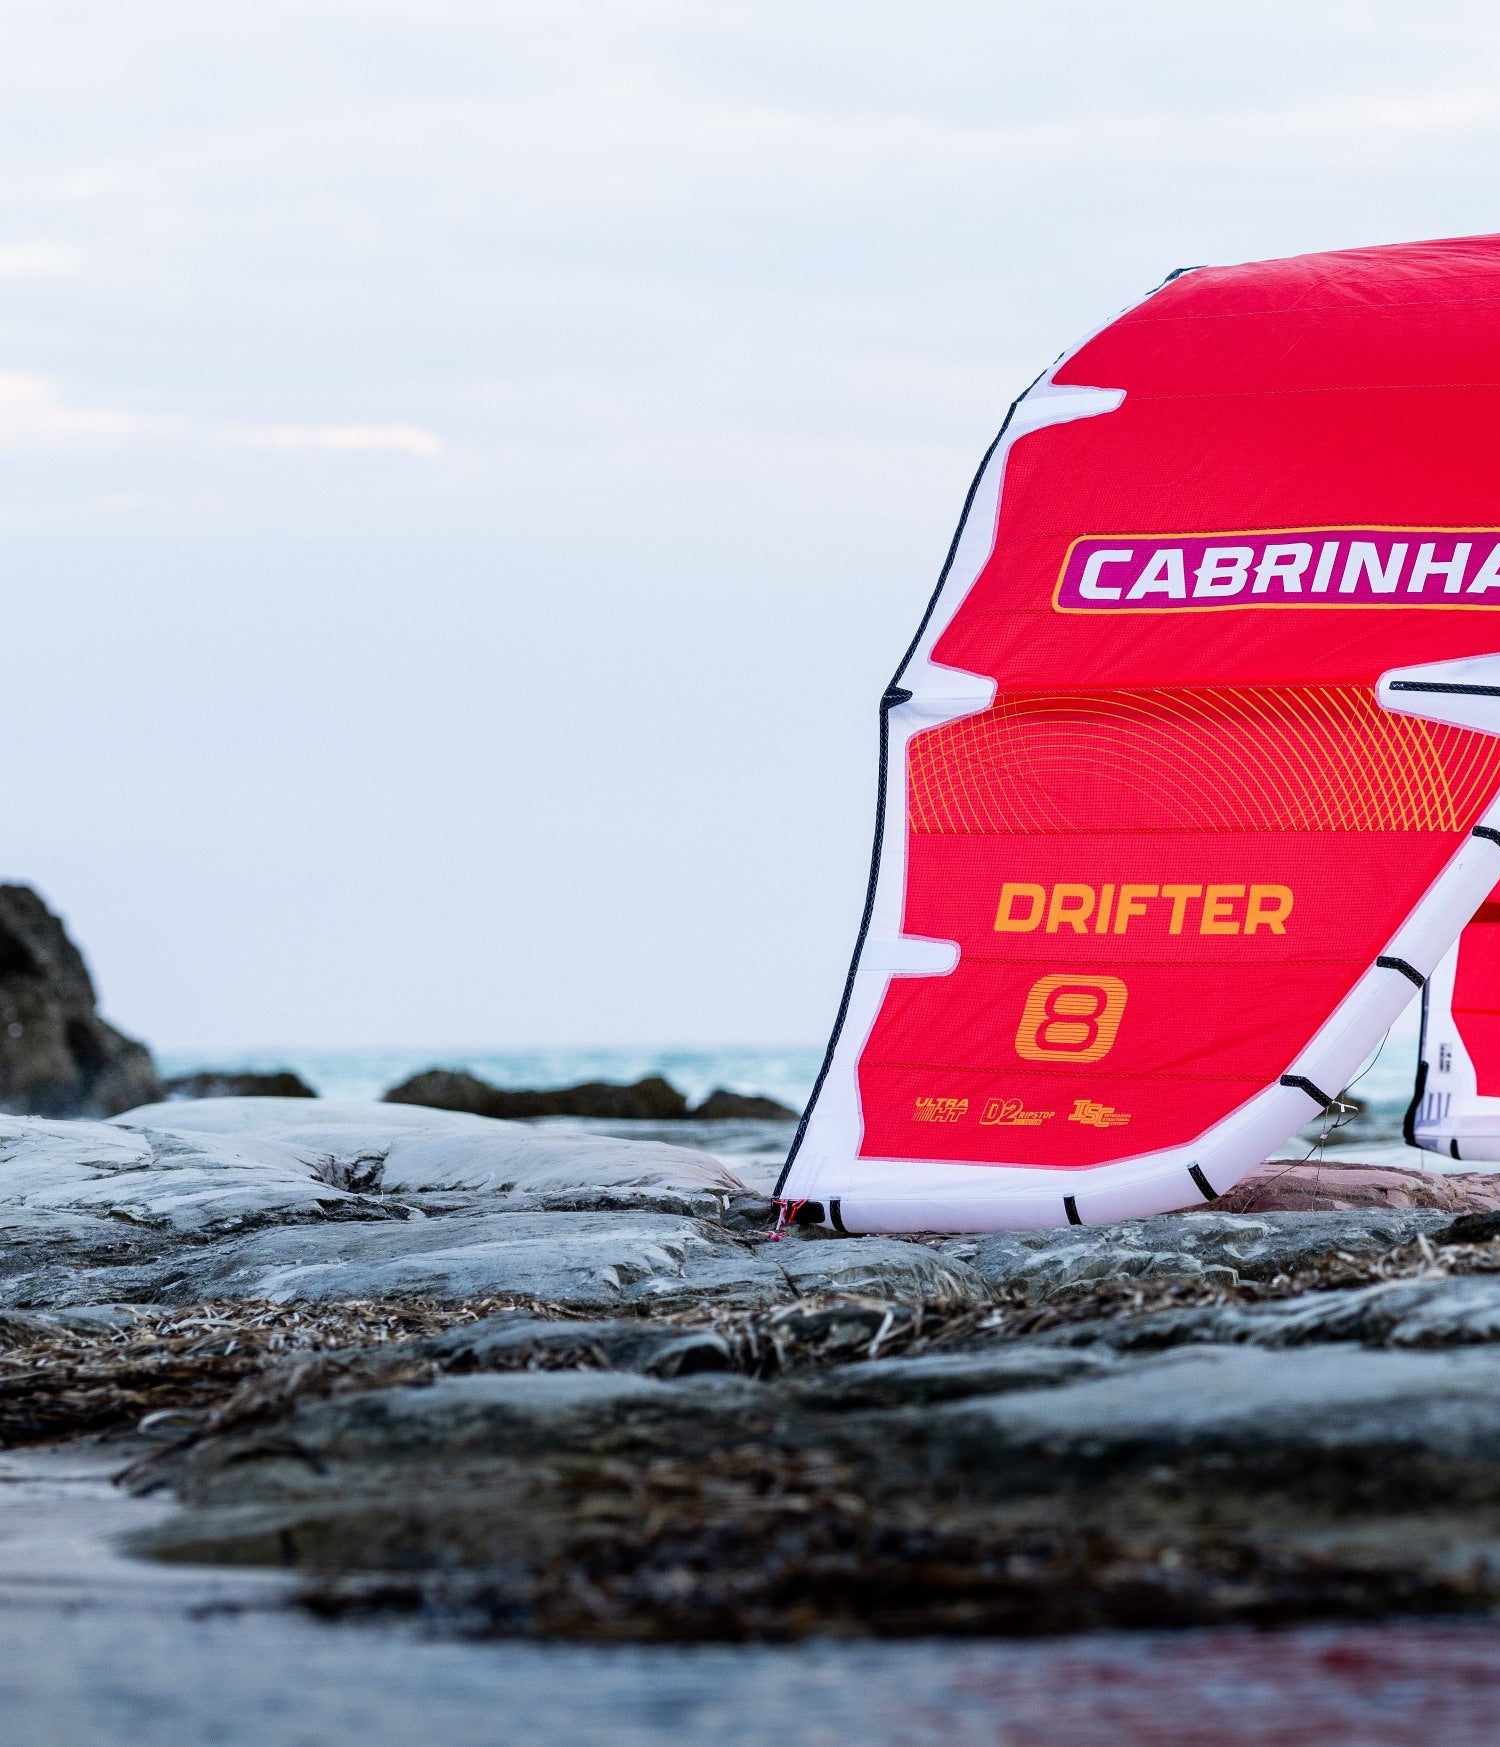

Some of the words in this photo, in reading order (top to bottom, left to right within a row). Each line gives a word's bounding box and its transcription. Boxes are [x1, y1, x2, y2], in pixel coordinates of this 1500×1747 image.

[993, 882, 1294, 935] DRIFTER
[1035, 984, 1108, 1053] 8
[915, 1097, 969, 1108] ULTRA
[929, 1107, 969, 1122] HT
[979, 1098, 1024, 1125] D2
[1018, 1111, 1056, 1119] RIPSTOP
[1069, 1099, 1115, 1127] ISC
